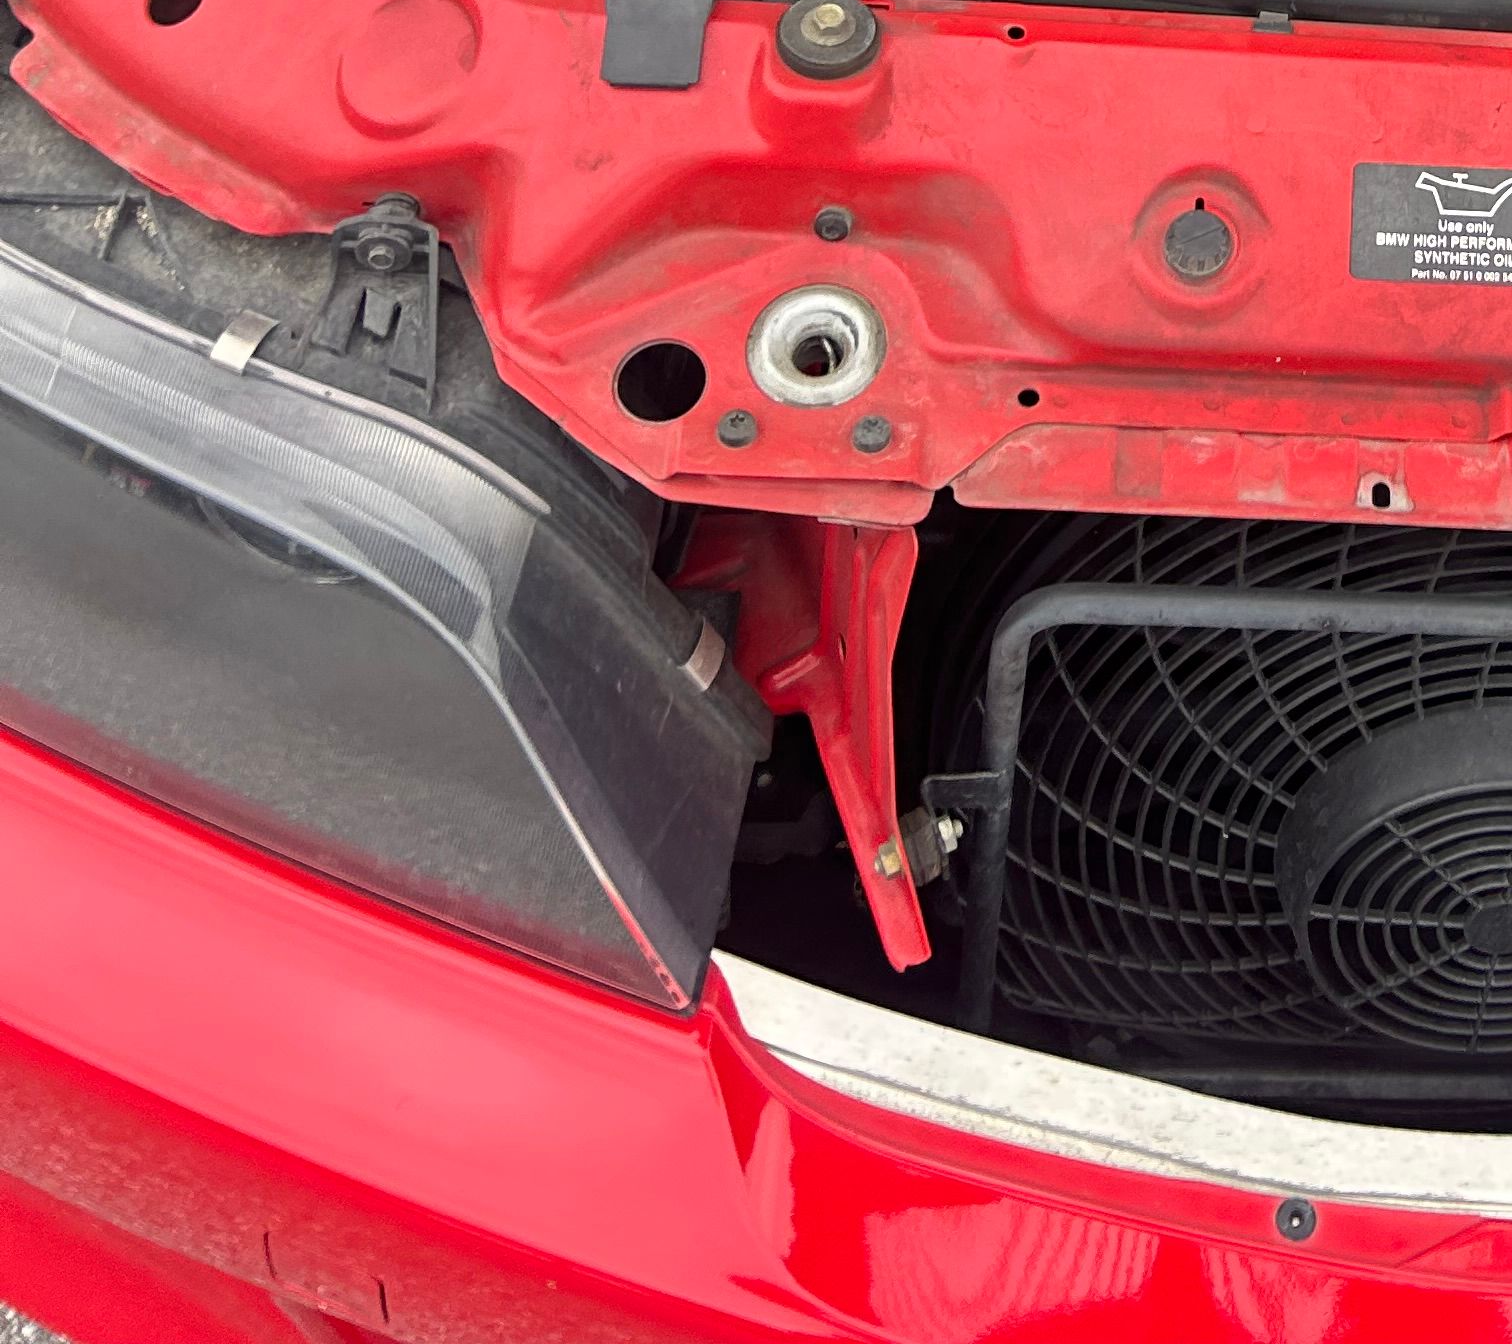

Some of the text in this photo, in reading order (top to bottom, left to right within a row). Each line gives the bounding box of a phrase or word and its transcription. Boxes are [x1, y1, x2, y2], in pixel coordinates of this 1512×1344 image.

[1438, 219, 1494, 236] Use only
[1376, 232, 1410, 246] BMW
[1413, 234, 1447, 248] HIGH
[1414, 250, 1490, 266] SYNTHETIC
[1411, 268, 1430, 280] Part
